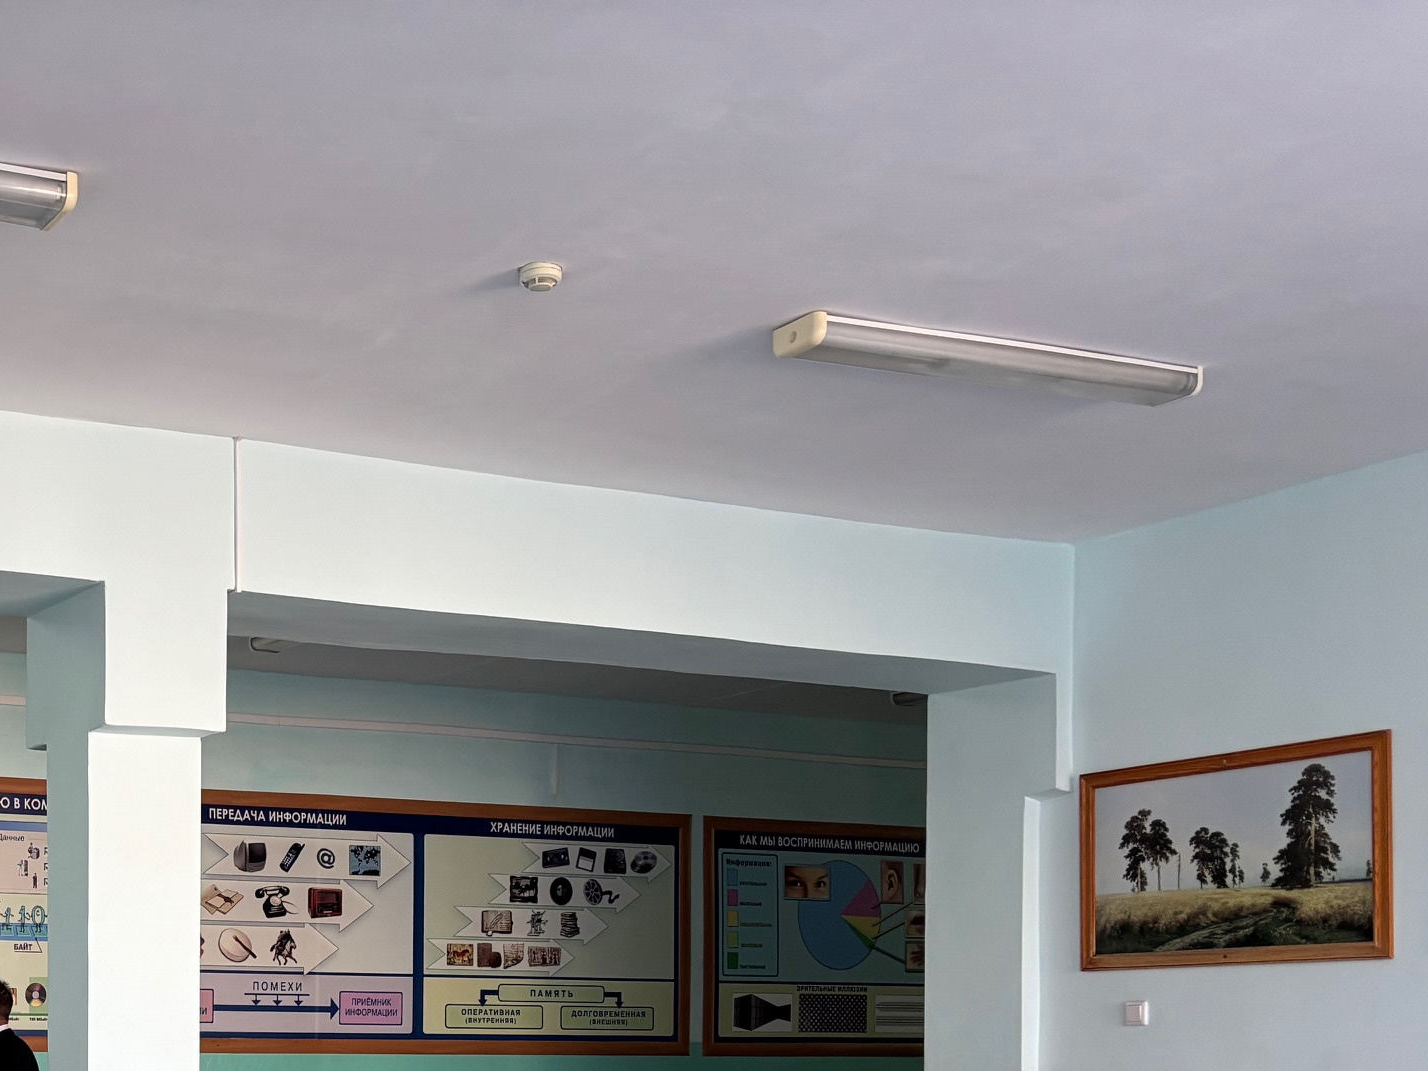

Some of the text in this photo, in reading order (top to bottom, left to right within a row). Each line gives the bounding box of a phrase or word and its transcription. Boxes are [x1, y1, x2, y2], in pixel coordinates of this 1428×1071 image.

[13, 798, 20, 809] В
[209, 807, 347, 826] ПЕРЕДАЧА ИНФОРМАЦИИ
[490, 821, 615, 838] ХРАНЕНИЕ ИНФОРМАЦИИ
[739, 834, 920, 853] КАК МЫ ВОСПРИНИМАЕМ ИНФОРМАЦИЮ
[13, 942, 33, 951] БАЙТ
[252, 981, 304, 992] ПОМЕХИ
[529, 989, 574, 999] ПАМЯТЬ
[351, 997, 392, 1007] ПРИЁМНИК
[344, 1008, 398, 1017] ИНФОРМАЦИИ
[461, 1008, 521, 1017] ОПЕРАТИВНАЯ
[570, 1009, 646, 1019] ДОЛГОВРЕМЕННАЯ
[465, 1017, 517, 1025] (ВНУТРЕННЯЯ)
